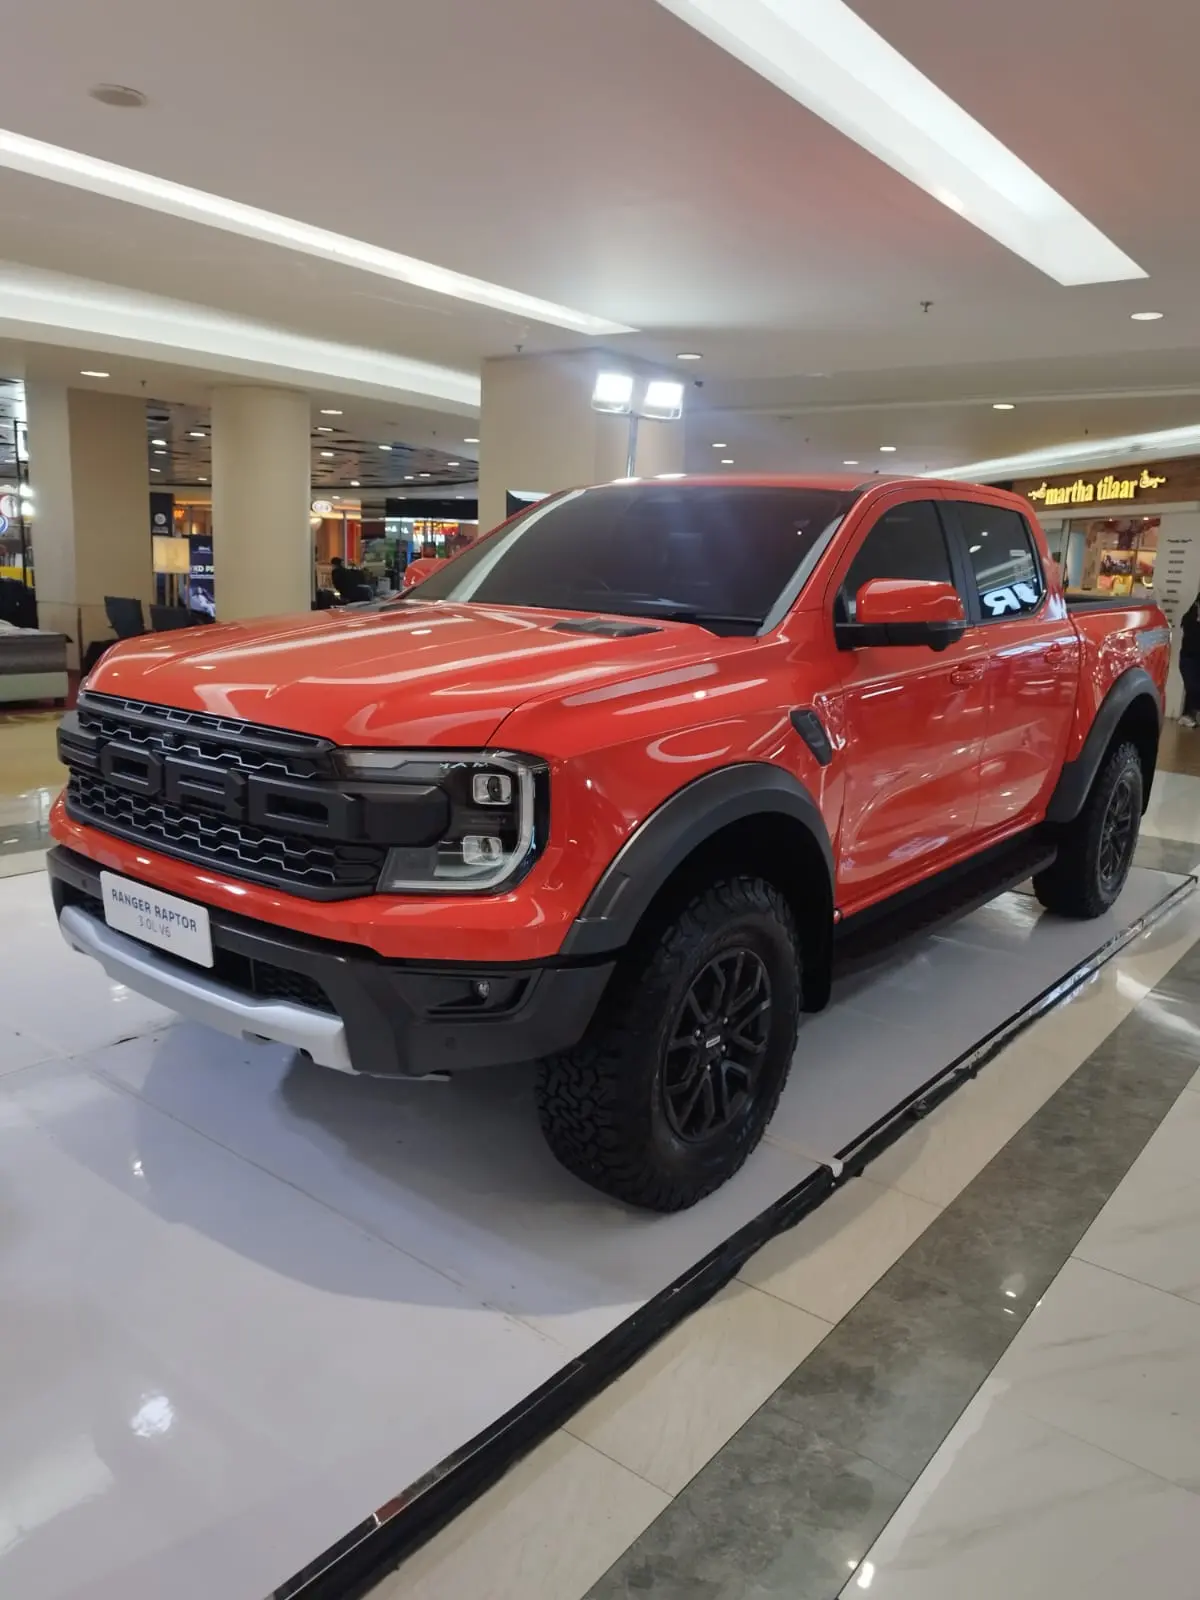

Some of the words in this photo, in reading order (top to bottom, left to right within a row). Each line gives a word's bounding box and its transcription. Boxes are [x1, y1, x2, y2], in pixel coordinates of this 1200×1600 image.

[1044, 479, 1094, 505] martha
[1096, 475, 1138, 501] tilaar
[112, 889, 151, 914] RANGER
[154, 905, 197, 933] RAPTOR
[159, 923, 171, 938] V6
